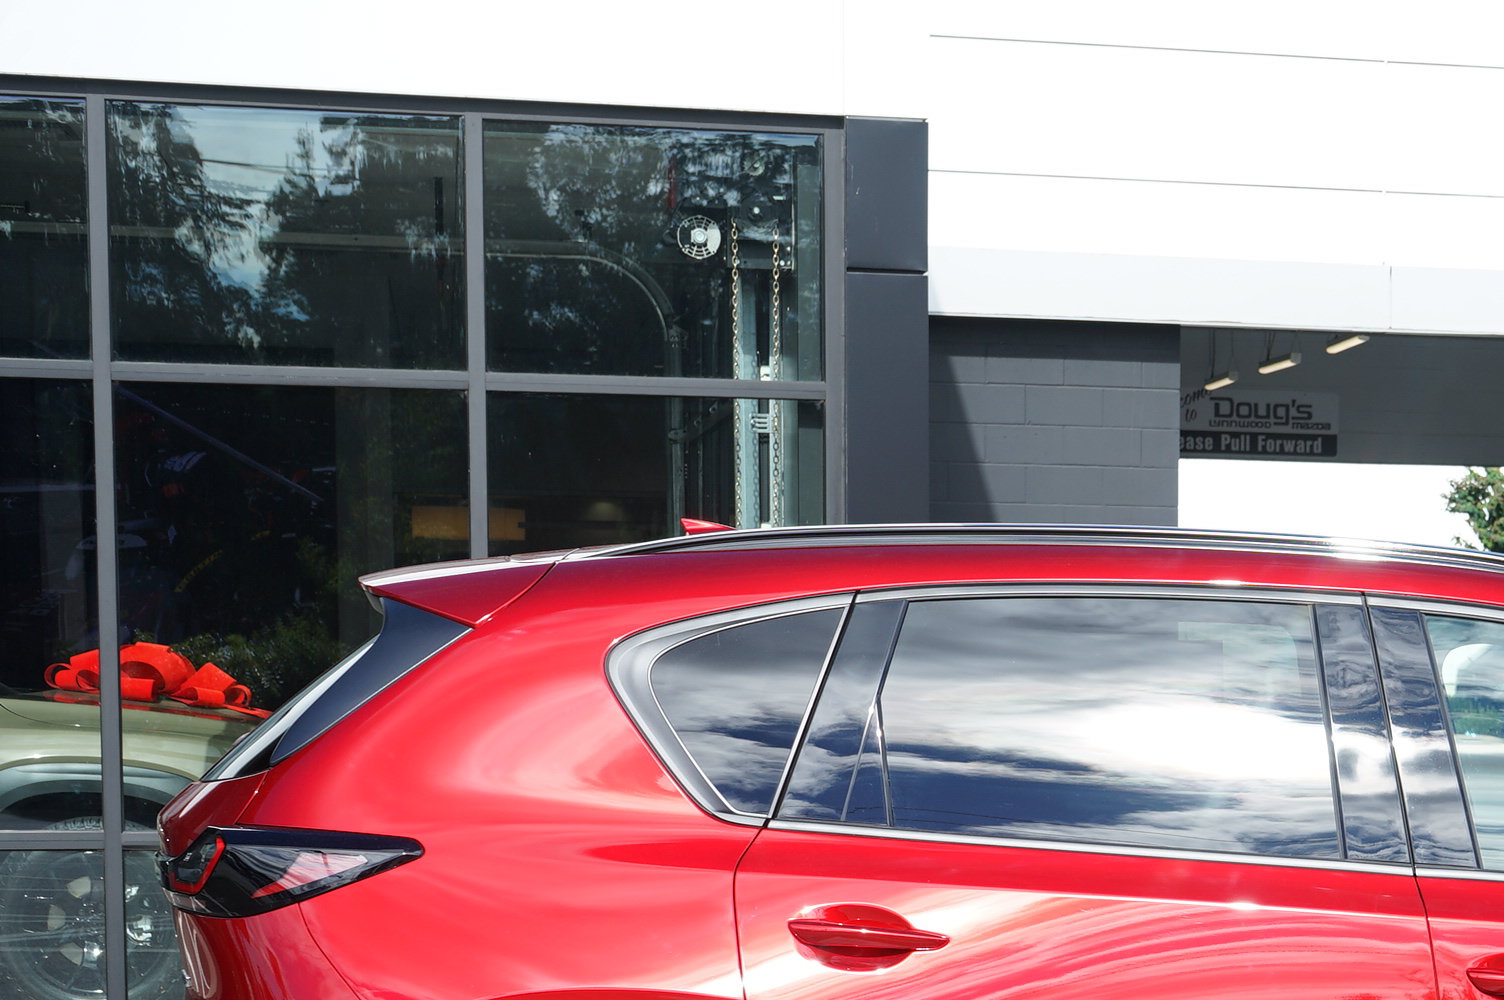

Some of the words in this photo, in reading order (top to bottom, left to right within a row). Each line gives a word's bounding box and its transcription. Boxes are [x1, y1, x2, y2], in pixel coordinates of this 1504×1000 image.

[1209, 396, 1313, 426] Doug's
[1221, 434, 1250, 451] Pull
[1258, 435, 1323, 453] Forward
